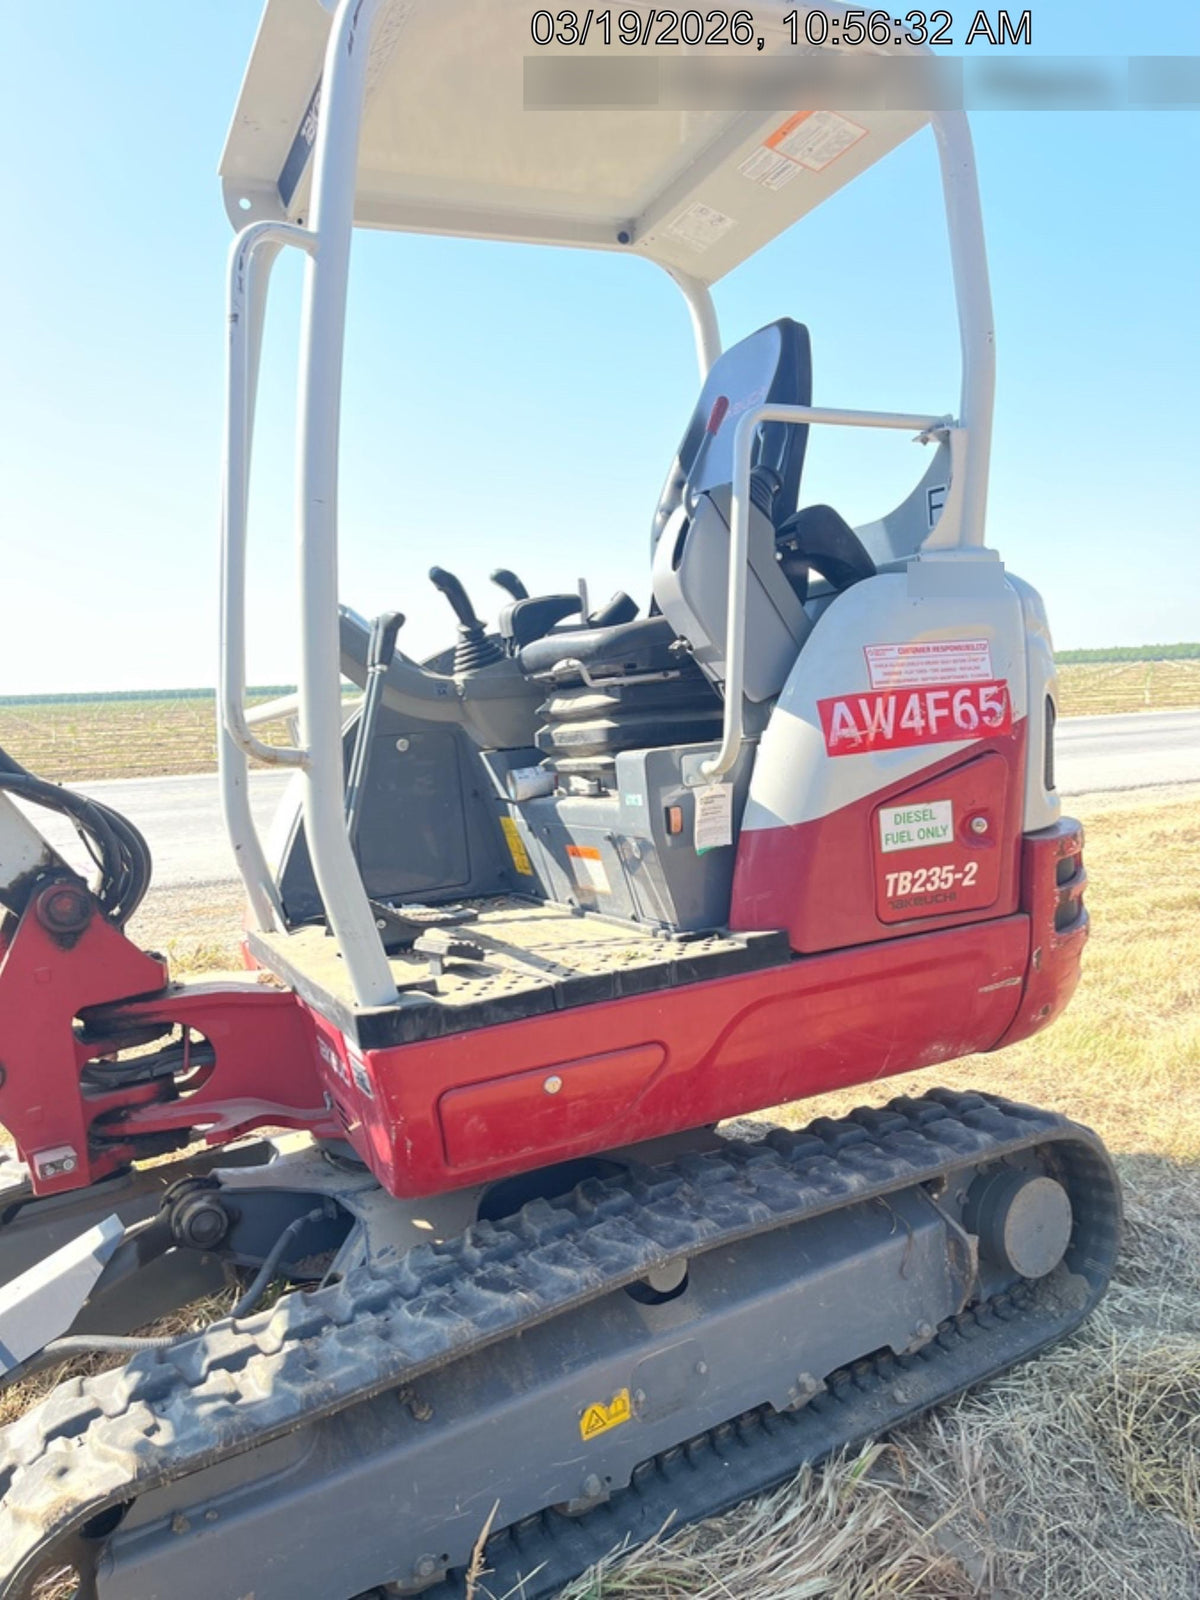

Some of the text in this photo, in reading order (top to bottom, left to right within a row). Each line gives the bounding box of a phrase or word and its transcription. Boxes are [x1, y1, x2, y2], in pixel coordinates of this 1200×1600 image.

[828, 685, 1006, 747] AW4F65
[893, 808, 936, 826] DIESEL
[885, 824, 949, 846] FUEL ONLY
[885, 861, 979, 898] TB235-2
